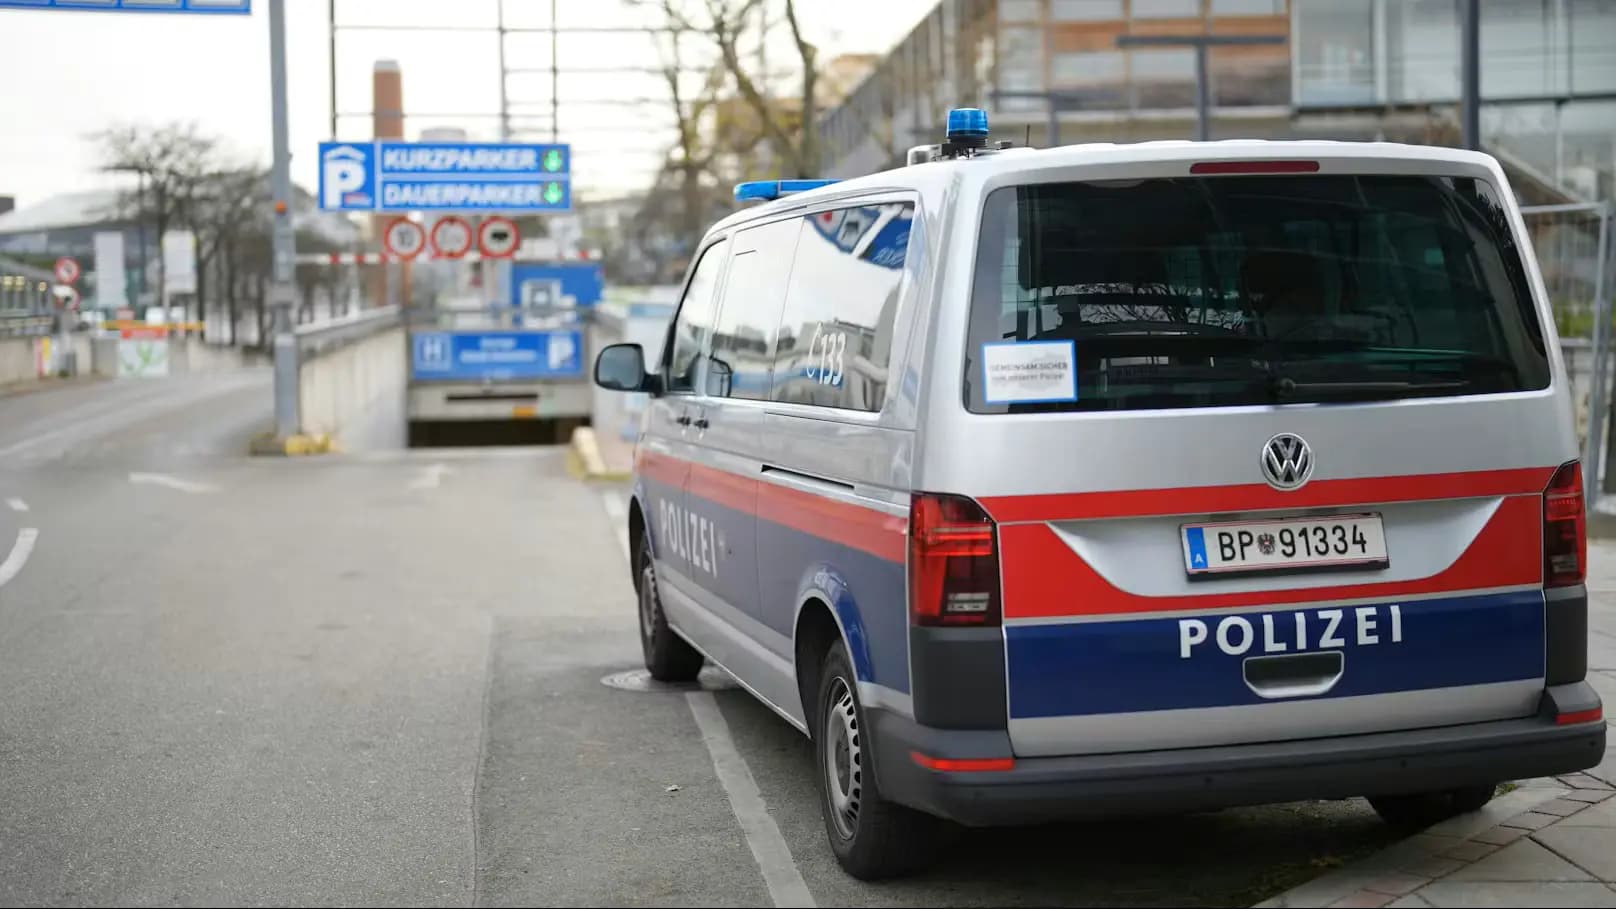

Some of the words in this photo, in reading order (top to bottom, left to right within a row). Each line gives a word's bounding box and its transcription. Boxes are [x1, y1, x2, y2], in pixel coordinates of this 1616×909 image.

[383, 149, 537, 170] KURZPARKER
[384, 184, 541, 206] DAUERPARKER
[819, 333, 845, 385] 133
[1265, 436, 1311, 486] VW
[660, 498, 717, 578] POLIZEI
[1194, 553, 1203, 563] A
[1218, 532, 1254, 561] BP
[1279, 525, 1367, 558] 91334
[1178, 605, 1402, 658] POLIZEI
